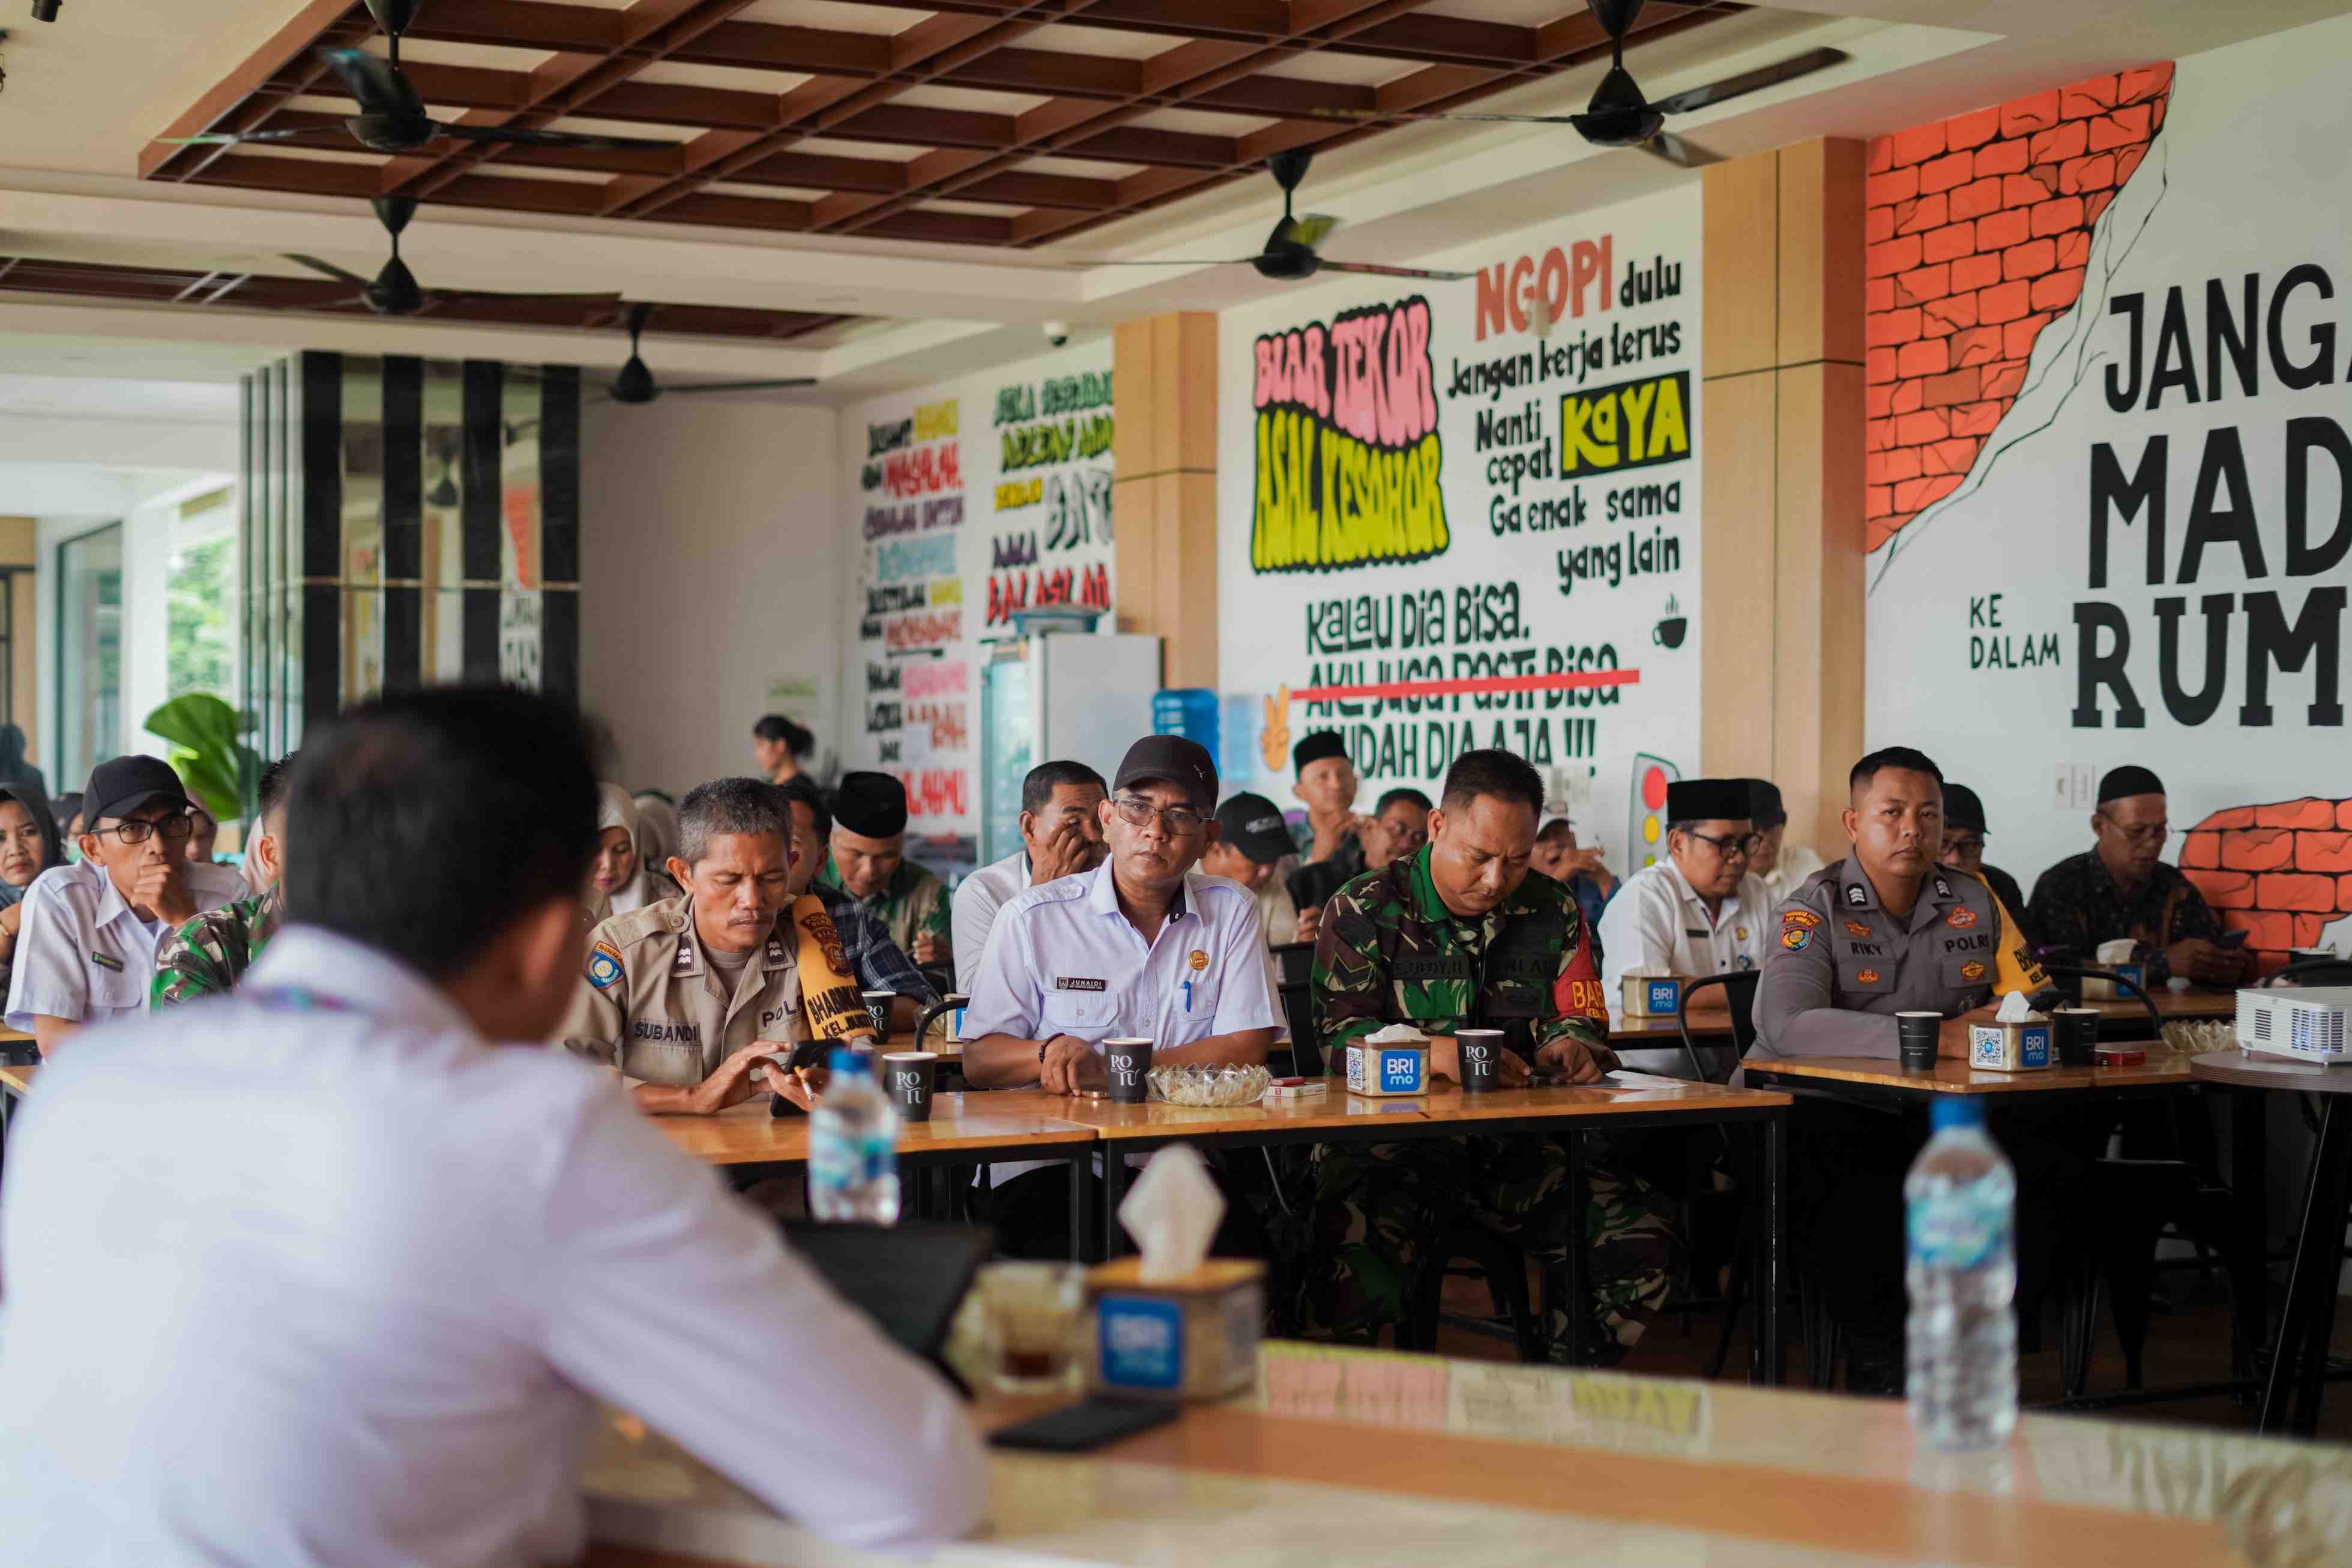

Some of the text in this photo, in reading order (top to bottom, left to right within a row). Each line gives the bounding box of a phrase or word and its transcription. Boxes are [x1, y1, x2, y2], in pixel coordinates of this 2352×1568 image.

[1476, 234, 1681, 342] NGOPI dulu
[2105, 264, 2352, 412] JANG
[1253, 322, 1331, 419] BIAR
[1331, 297, 1438, 448] TEKOR
[1447, 321, 1681, 401] Jangan kerja terus
[1476, 399, 1541, 452] Nanti
[1488, 436, 1553, 495] cepat
[1252, 409, 1449, 570] ASAL KESOHOR
[1490, 480, 1680, 536] Ga enak sama
[1557, 525, 1680, 595] yang lain
[1970, 593, 2003, 628] KE
[1971, 633, 2060, 669] DALAM
[2071, 586, 2347, 728] RUM
[1306, 660, 1364, 717] AKU
[1850, 941, 1883, 956] RIKY
[1944, 933, 1990, 953] POLRI
[1652, 988, 1673, 1001] BRI
[633, 1021, 698, 1042] SUBANDI
[2026, 1036, 2045, 1051] BRI
[1111, 1055, 1133, 1070] RO
[1386, 1058, 1414, 1075] BRI
[1465, 1045, 1488, 1061] RO
[2028, 1051, 2045, 1061] mo
[896, 1072, 920, 1088] RO
[1390, 1075, 1414, 1085] mo
